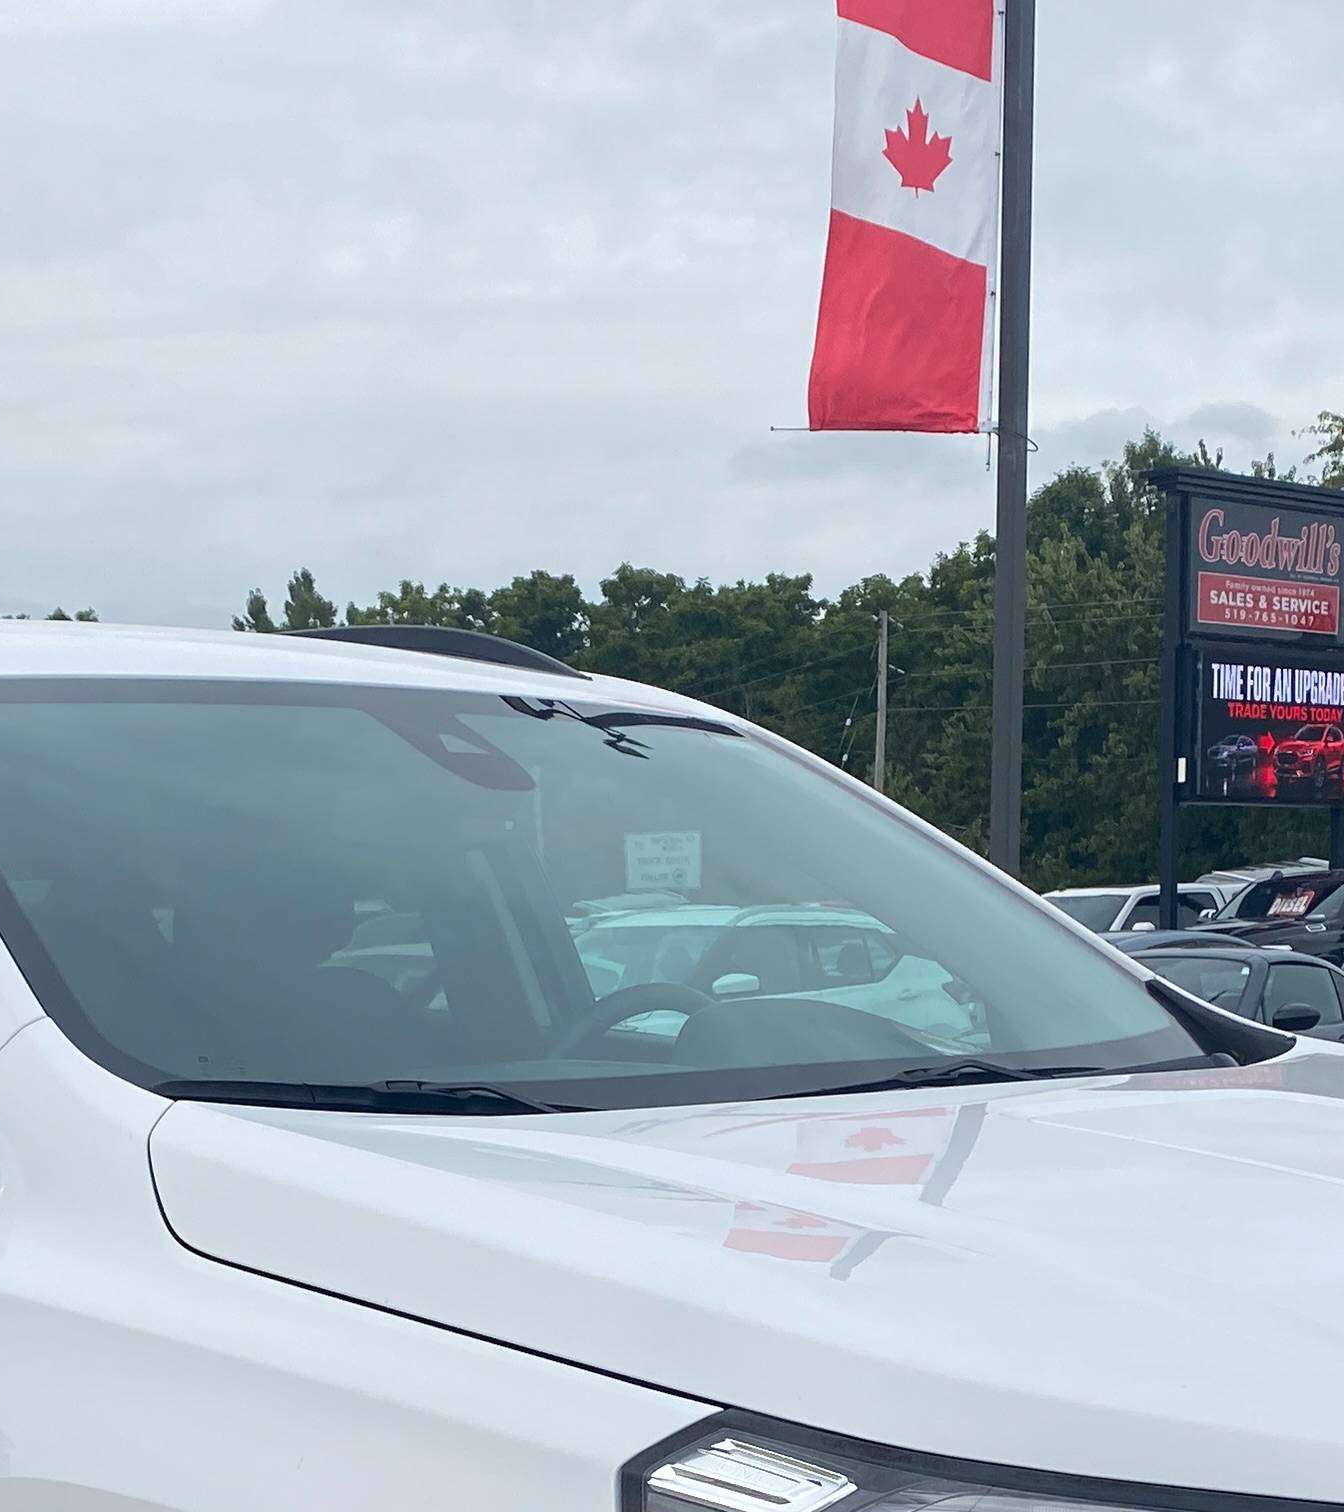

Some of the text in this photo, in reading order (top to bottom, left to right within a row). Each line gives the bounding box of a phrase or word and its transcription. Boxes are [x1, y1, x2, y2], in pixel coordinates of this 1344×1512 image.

[1198, 508, 1341, 576] Goodwill's
[1225, 580, 1249, 592] Family
[1251, 584, 1276, 594] owned
[1277, 586, 1297, 597] since
[1209, 589, 1329, 615] SALES & SERVICE
[1224, 608, 1315, 627] 519-765-1047
[1211, 663, 1244, 700] TIME
[1247, 665, 1271, 702] FOR
[1273, 667, 1292, 703] AN
[1228, 701, 1344, 722] TRADE YOURS TODAY
